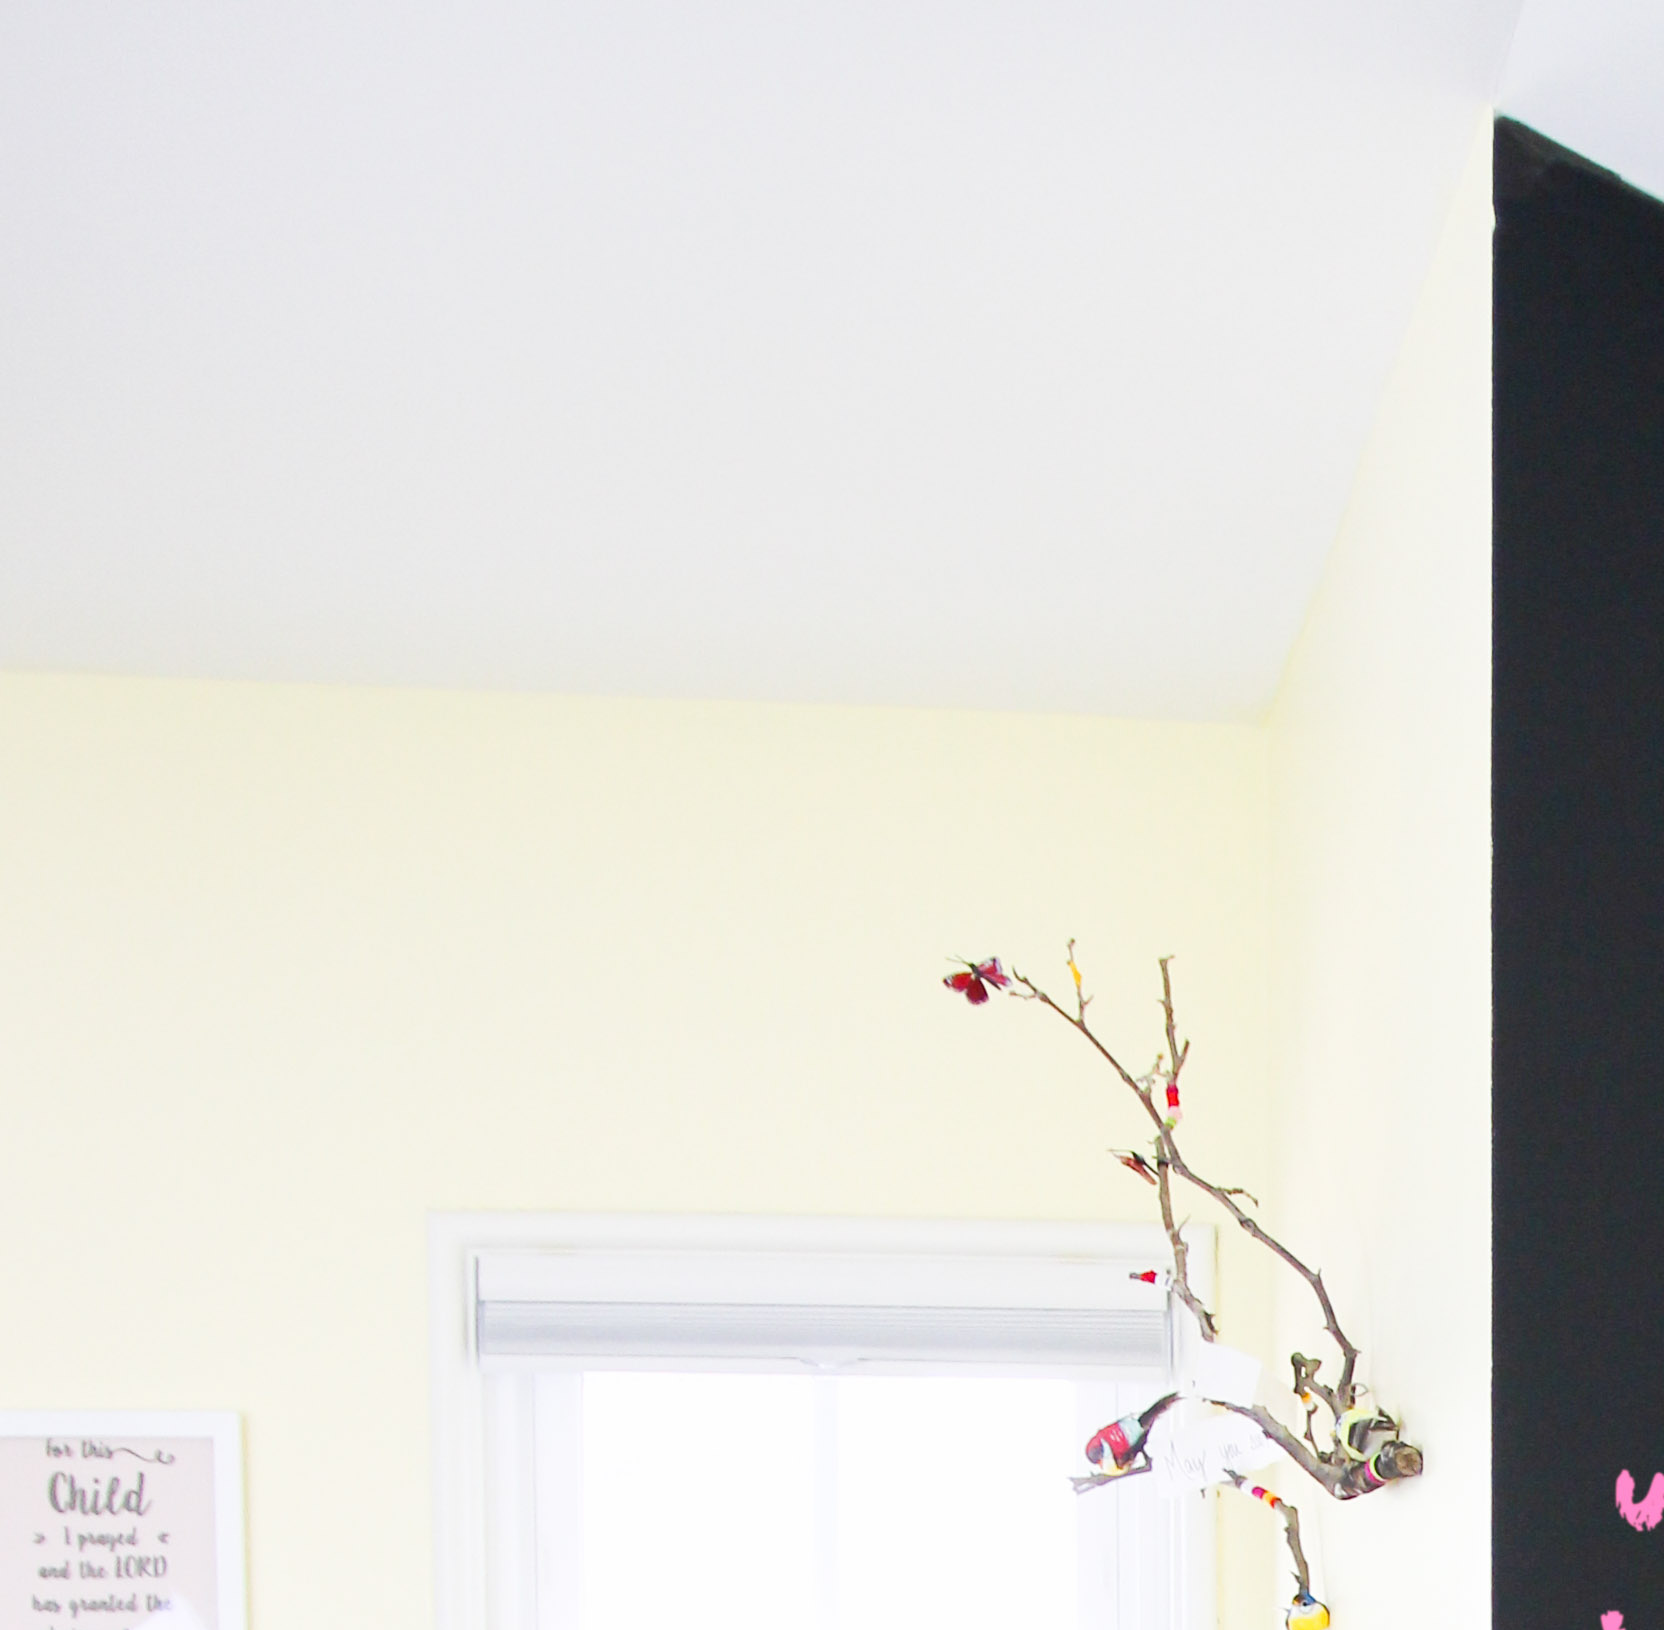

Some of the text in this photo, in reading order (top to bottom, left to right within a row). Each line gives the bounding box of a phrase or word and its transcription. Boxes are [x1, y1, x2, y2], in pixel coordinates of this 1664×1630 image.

[48, 1470, 153, 1516] Child
[38, 1554, 168, 1579] and the LORD
